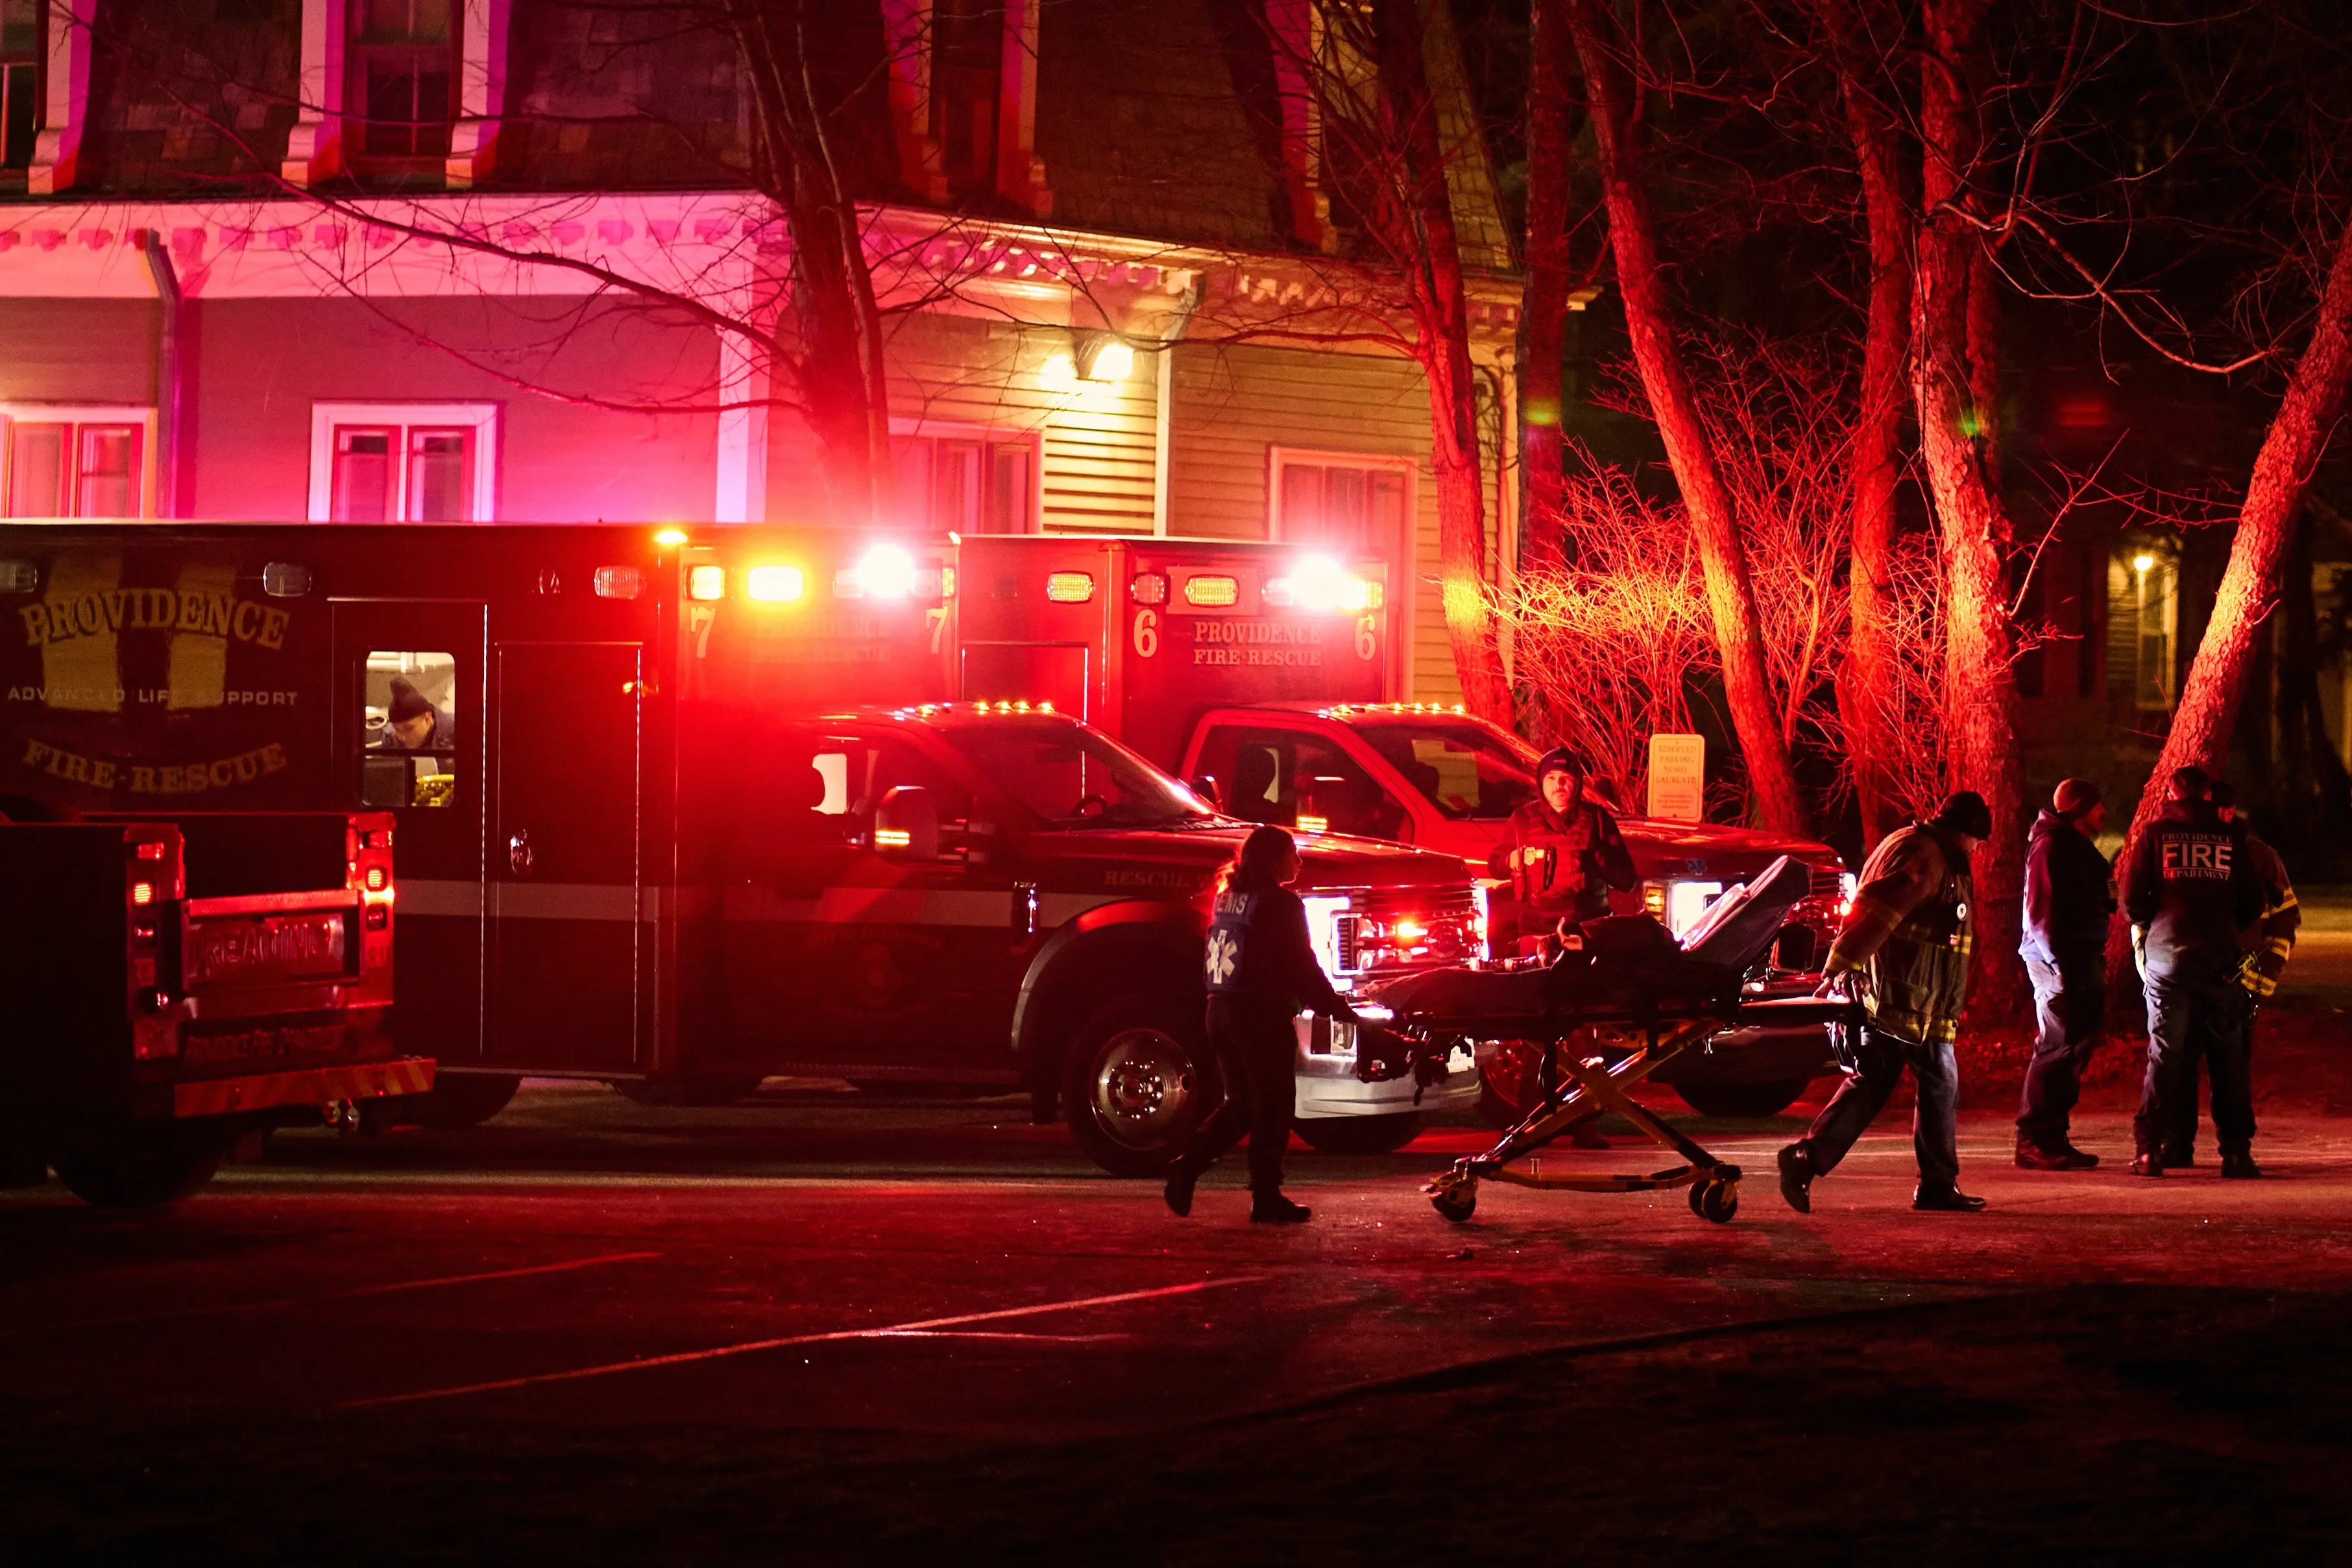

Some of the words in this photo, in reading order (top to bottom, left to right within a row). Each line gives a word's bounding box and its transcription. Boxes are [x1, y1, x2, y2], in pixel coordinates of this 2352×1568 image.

[18, 586, 290, 650] PROVIDENCE
[690, 607, 715, 658] 7
[925, 605, 949, 655] 7
[1134, 609, 1158, 658] 6
[1194, 621, 1322, 644] PROVIDENCE
[1355, 614, 1377, 661] 6
[138, 688, 183, 704] LIF
[196, 690, 298, 706] UPPORT
[2162, 832, 2232, 843] PROVIDENCE
[2163, 843, 2233, 871] FIRE
[2163, 869, 2230, 881] DEPARTMENT
